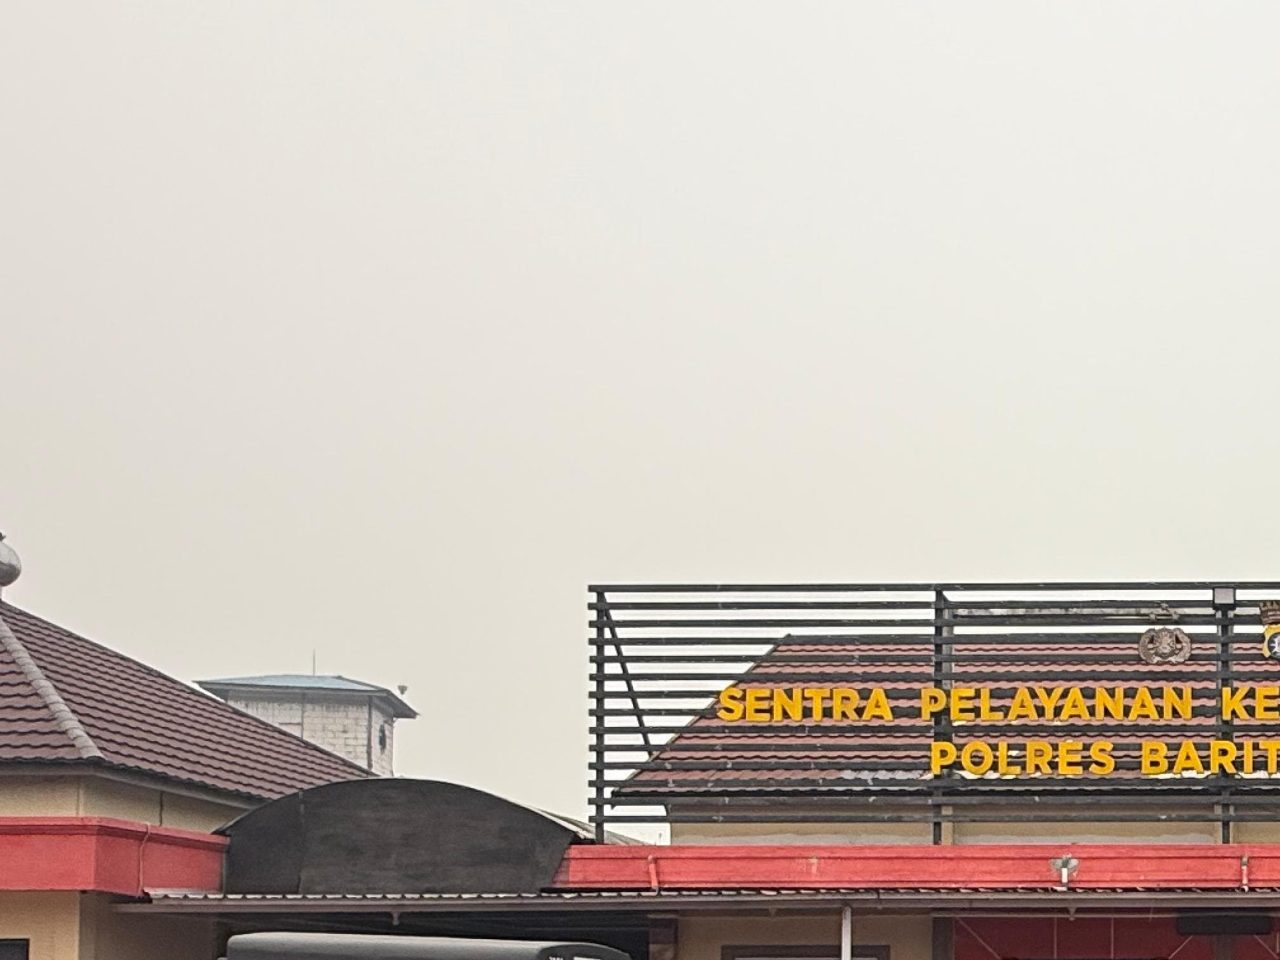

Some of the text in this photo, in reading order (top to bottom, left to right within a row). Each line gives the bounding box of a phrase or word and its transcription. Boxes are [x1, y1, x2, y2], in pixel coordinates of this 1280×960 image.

[717, 687, 894, 723] SENTRA
[920, 686, 1194, 722] PELAYANAN
[930, 740, 1116, 776] POLRES
